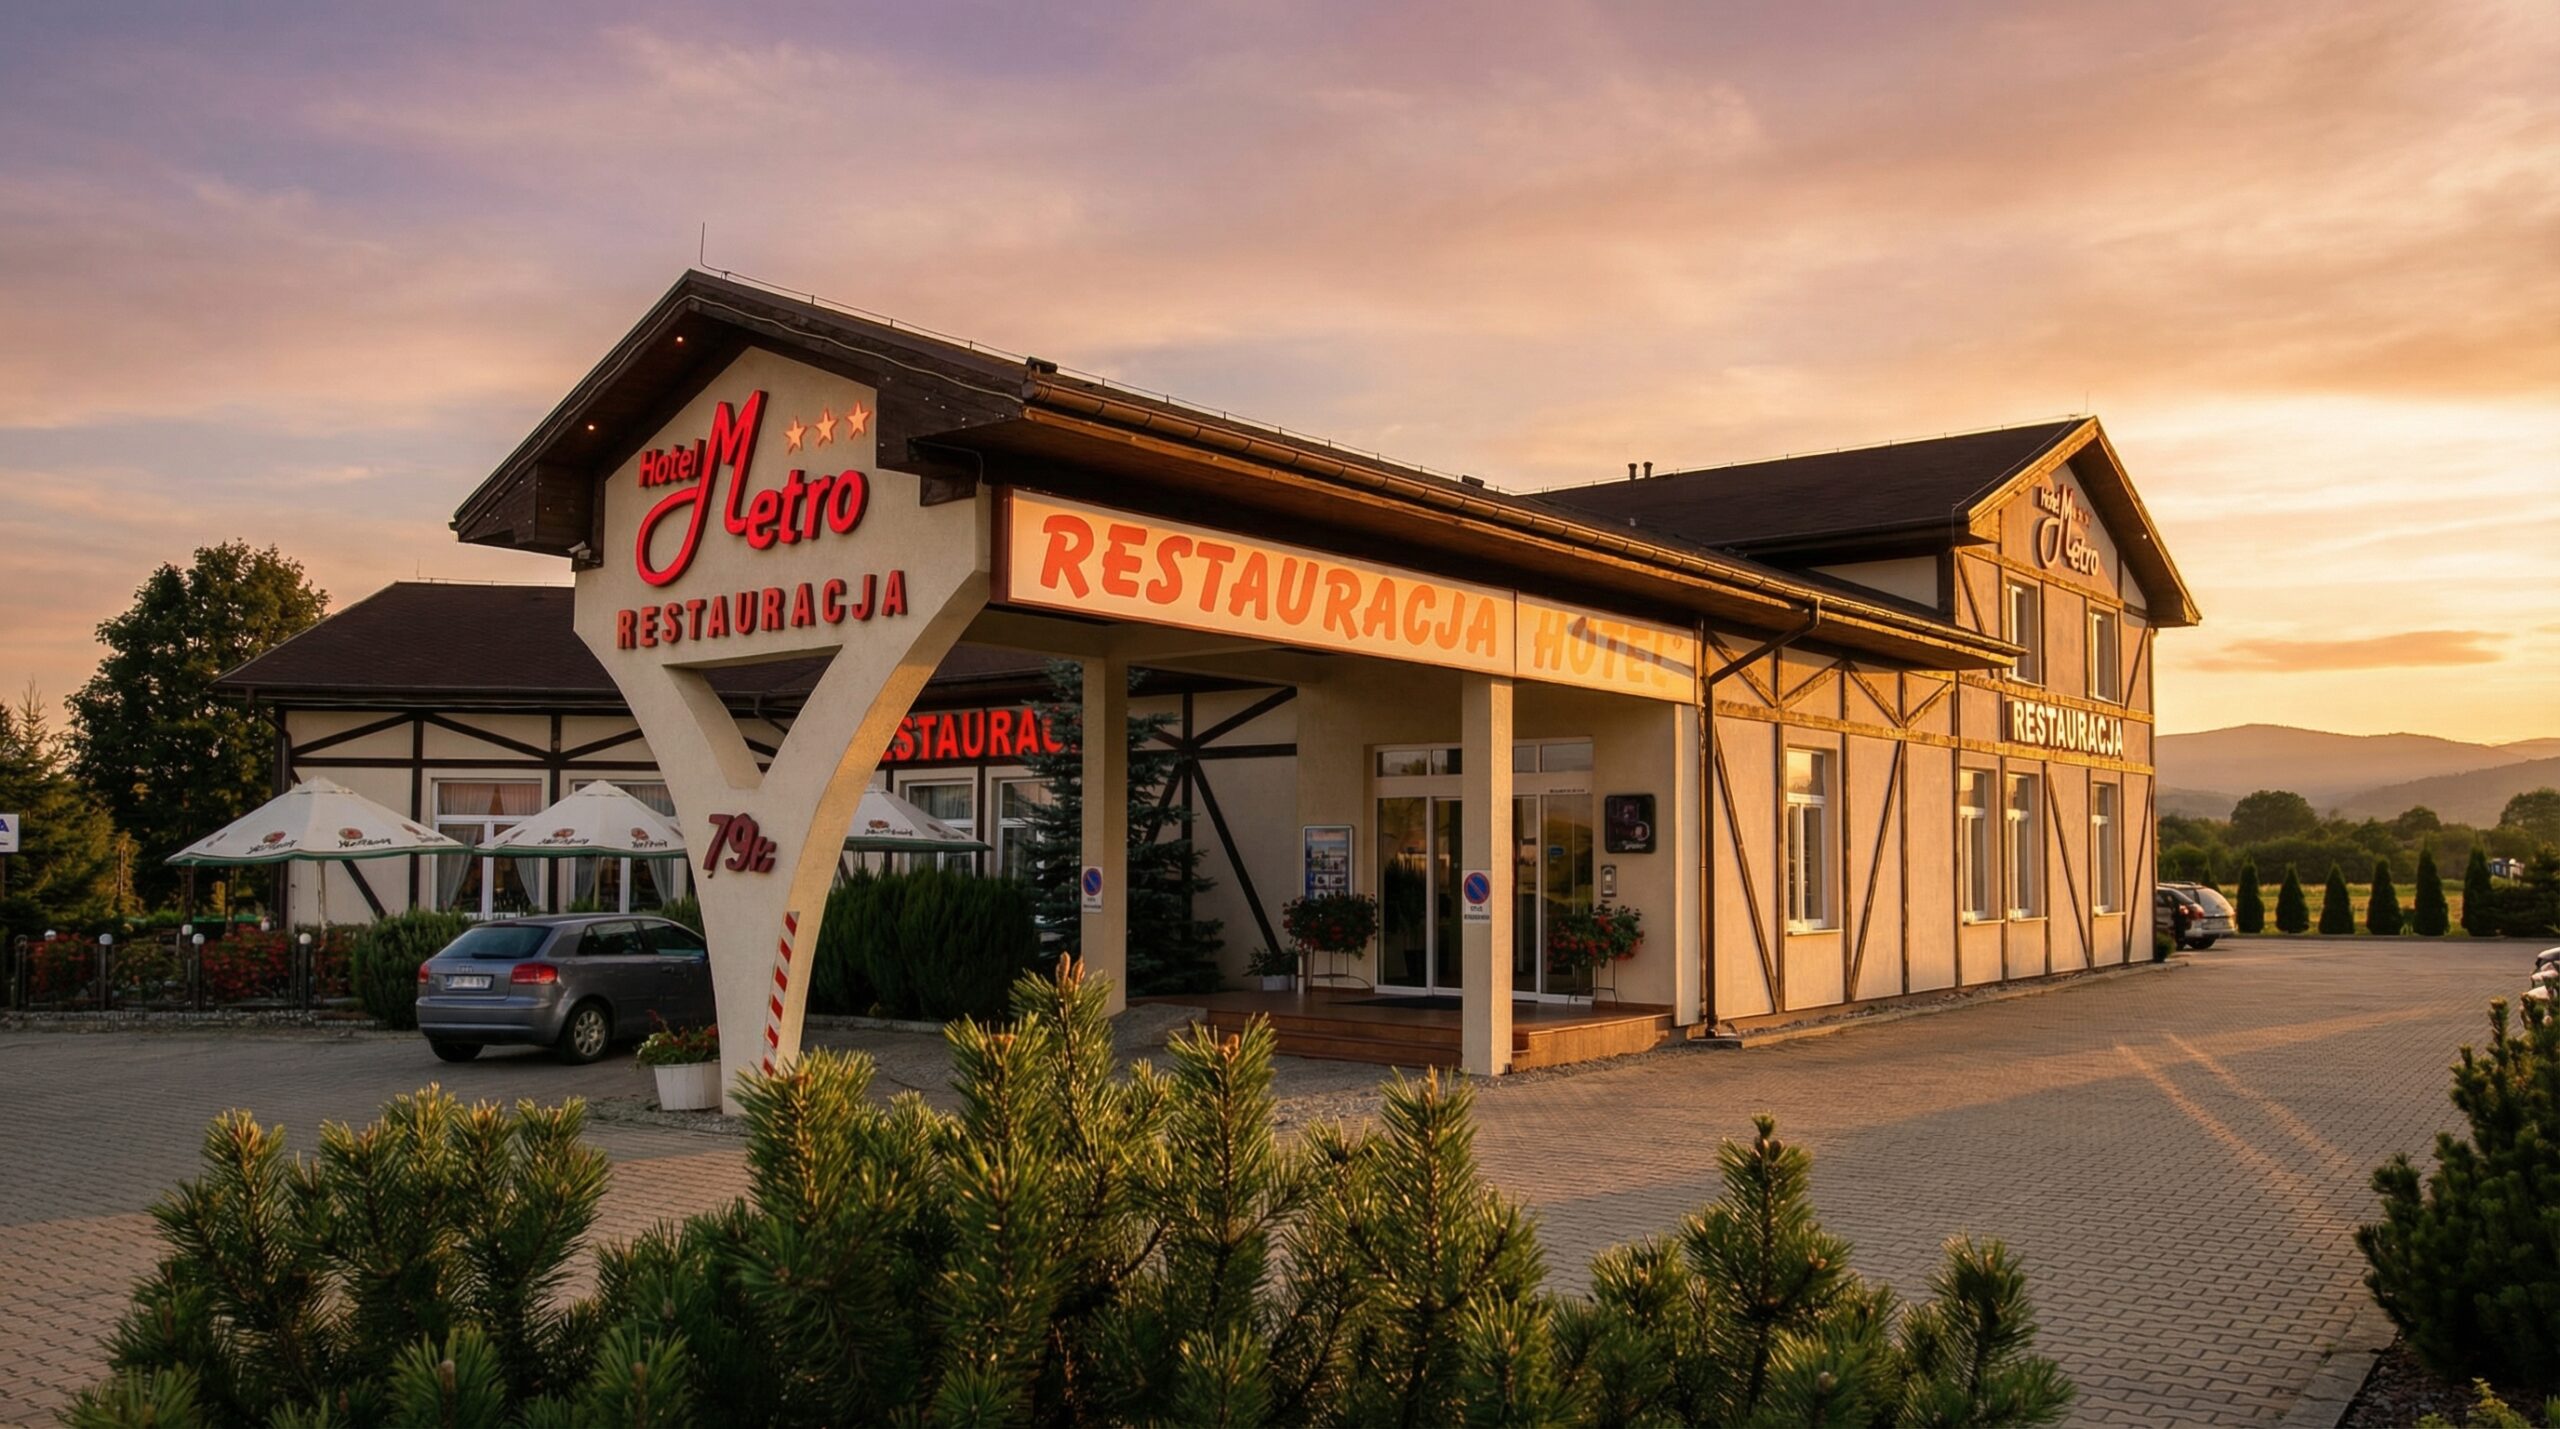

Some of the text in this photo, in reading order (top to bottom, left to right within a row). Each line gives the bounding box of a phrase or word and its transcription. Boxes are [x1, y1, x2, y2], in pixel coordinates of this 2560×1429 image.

[636, 389, 870, 588] Metro
[639, 438, 706, 488] Hotel
[617, 570, 908, 649] RESTAURACJA
[1039, 514, 1498, 658] RESTAURACJA
[1533, 610, 1669, 689] HOTEL
[2013, 700, 2123, 756] RESTAURACJA
